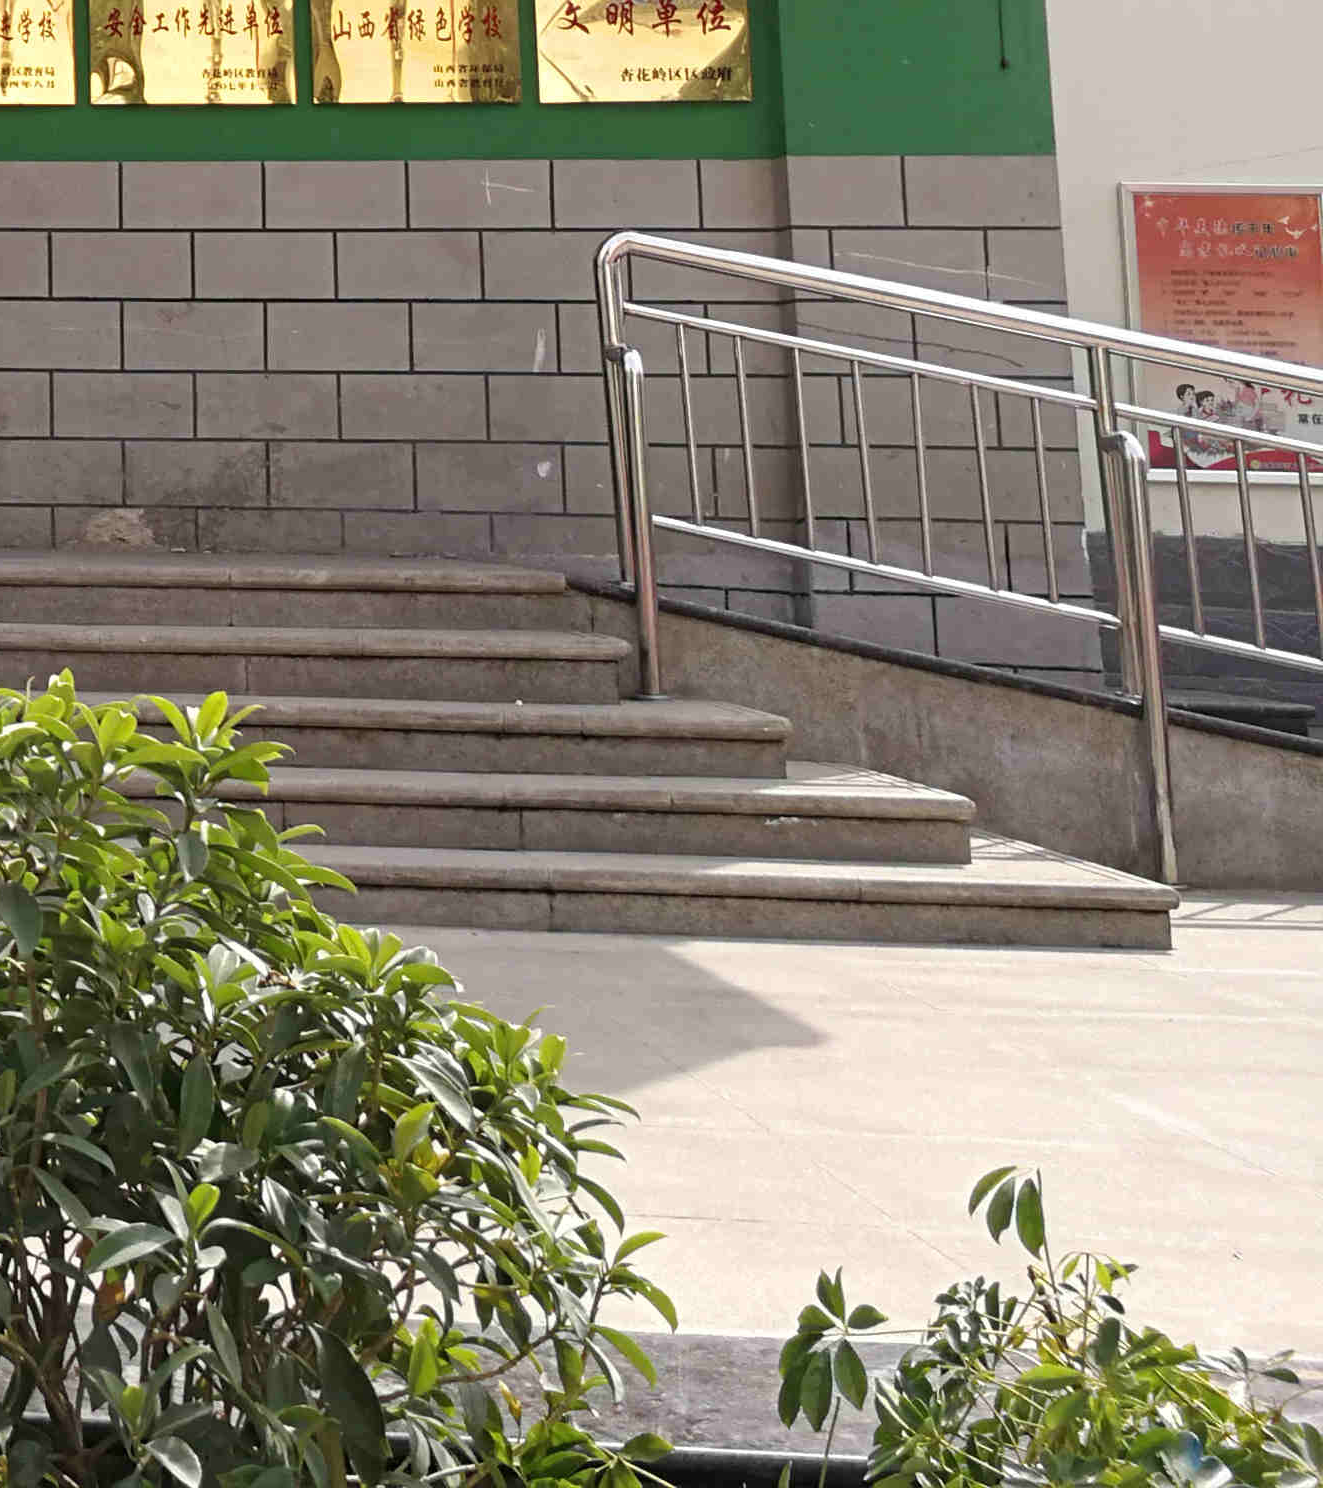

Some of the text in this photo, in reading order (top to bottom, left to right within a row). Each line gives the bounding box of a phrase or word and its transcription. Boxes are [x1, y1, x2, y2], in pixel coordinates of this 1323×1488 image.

[104, 4, 283, 40] 安全工作先进单位
[333, 5, 502, 45] 山西省绿色学校
